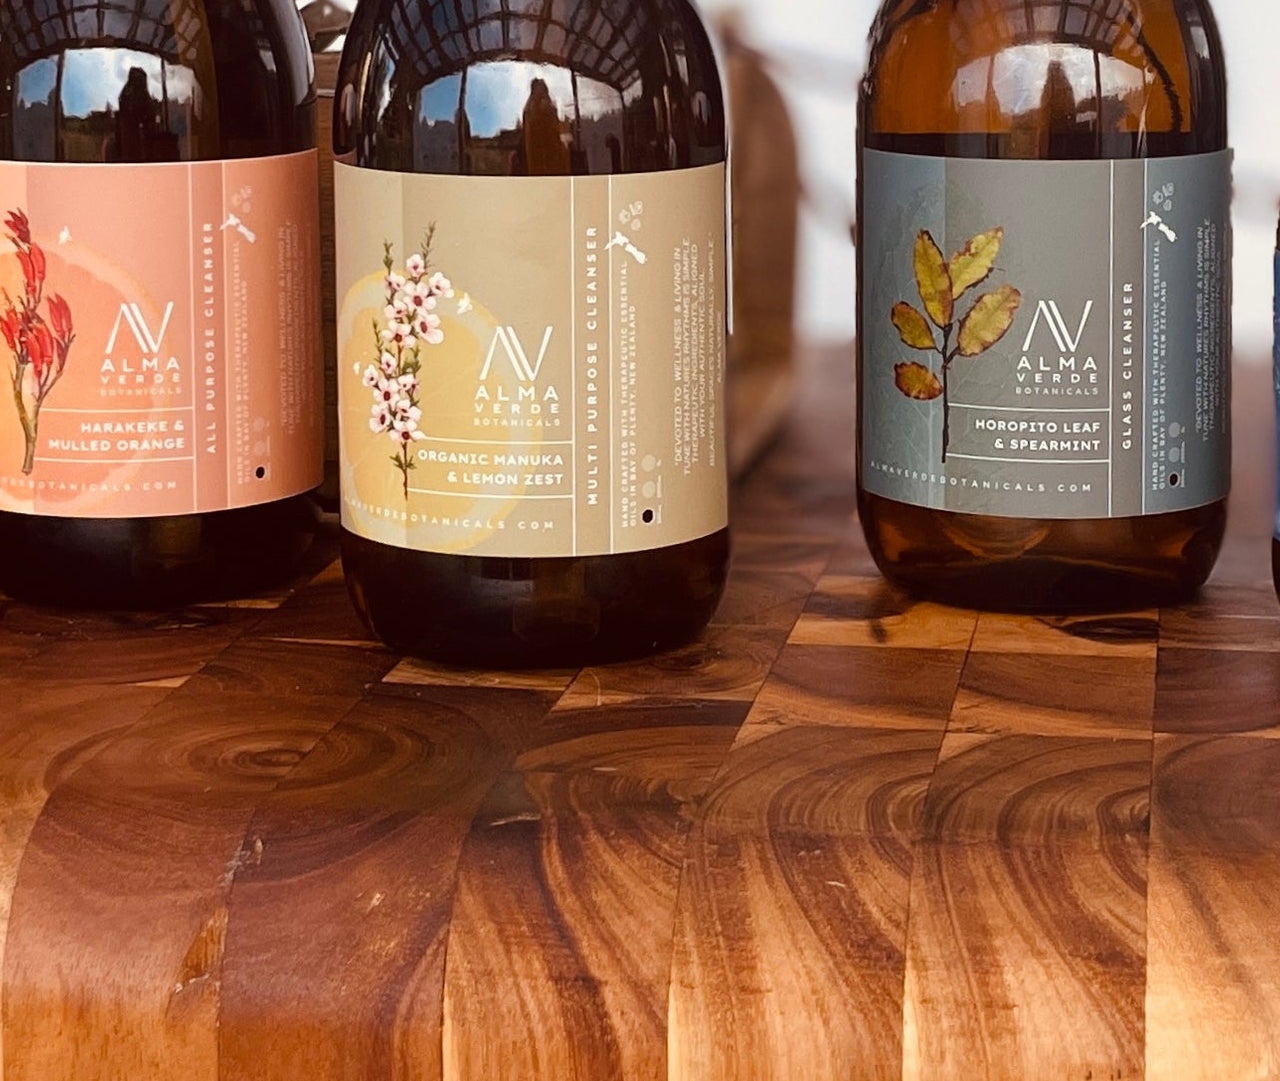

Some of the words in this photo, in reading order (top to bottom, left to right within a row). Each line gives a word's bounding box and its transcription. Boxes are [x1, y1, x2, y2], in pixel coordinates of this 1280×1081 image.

[203, 222, 214, 318] CLEANSER
[586, 227, 597, 330] CLEANSER
[1122, 282, 1133, 380] CLEANSER
[100, 356, 180, 372] ALMA
[204, 327, 216, 412] PURPOSE
[1016, 356, 1097, 370] ALMA
[100, 372, 180, 384] VERDE
[1016, 373, 1098, 384] VERDE
[475, 385, 558, 401] ALMA
[587, 342, 598, 432] PURPOSE
[1016, 387, 1098, 395] BOTANICALS
[474, 403, 559, 414] VERDE
[629, 390, 637, 436] PLENTY,
[81, 420, 168, 433] HARAKEKE
[174, 420, 184, 431] &
[474, 418, 560, 426] BOTANICALS
[975, 419, 1058, 432] HOROPITO
[1064, 422, 1100, 432] LEAF
[1122, 390, 1132, 450] GLASS
[48, 439, 111, 451] MULLED
[117, 438, 184, 451] ORANGE
[206, 422, 217, 454] ALL
[994, 438, 1004, 448] &
[1010, 439, 1100, 450] SPEARMINT
[418, 450, 488, 464] ORGANIC
[494, 454, 564, 466] MANUKA
[448, 472, 458, 482] &
[463, 472, 518, 484] LEMON
[524, 474, 564, 486] ZEST
[588, 443, 598, 505] MULTI
[629, 501, 637, 526] OILS
